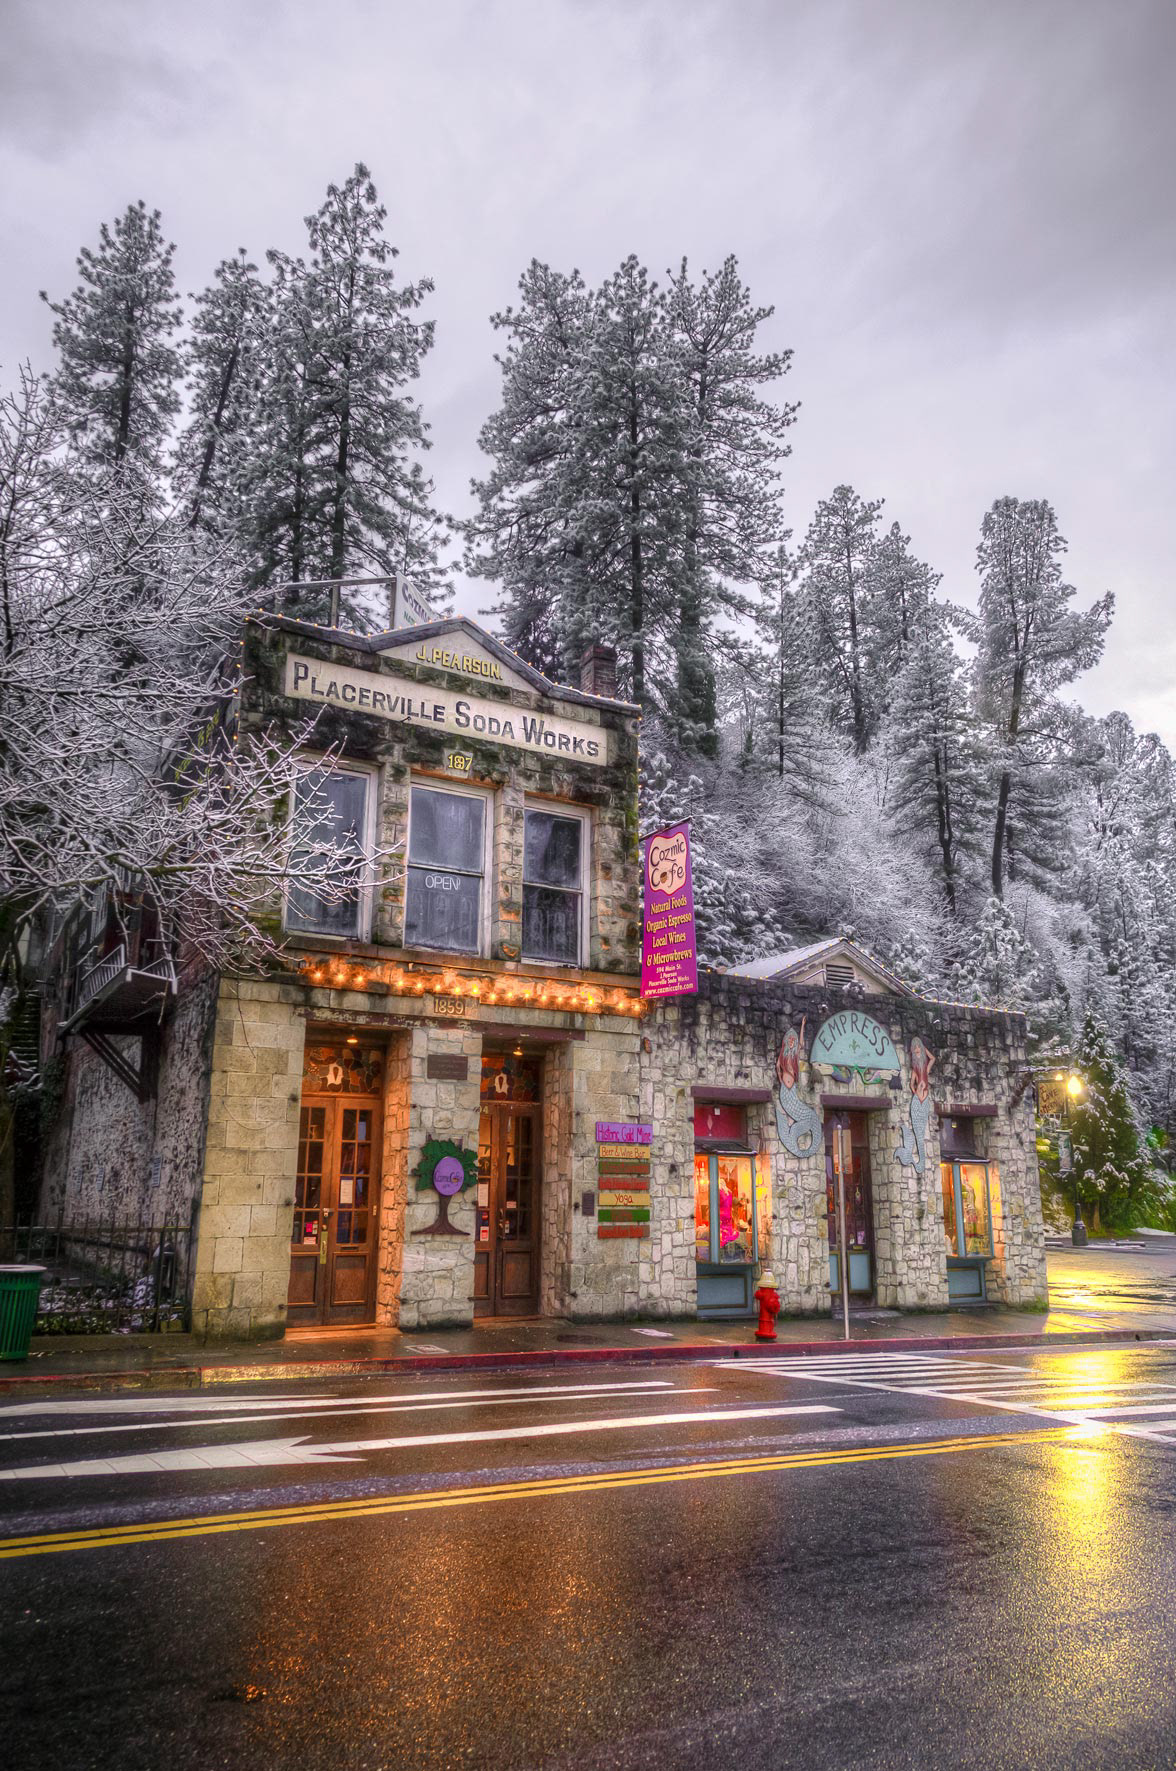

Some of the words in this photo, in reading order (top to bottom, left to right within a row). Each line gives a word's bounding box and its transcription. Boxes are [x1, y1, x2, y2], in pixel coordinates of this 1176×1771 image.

[294, 661, 445, 723] PLACERVILLE
[455, 700, 515, 739] SODA
[522, 715, 599, 758] WORKS
[650, 839, 685, 867] Cozmic
[425, 874, 459, 890] OPEN
[650, 899, 671, 915] Natural
[671, 895, 687, 909] Foods
[646, 916, 667, 933] Organic
[668, 912, 692, 928] Espresso
[652, 933, 667, 948] Local
[668, 931, 686, 945] Wines
[664, 964, 676, 972] Main
[648, 978, 667, 987] Placerville
[667, 976, 678, 984] Soda
[434, 999, 464, 1014] 1859
[818, 1012, 890, 1056] EMPRESS
[602, 1146, 614, 1156] Beer
[620, 1147, 633, 1157] Wine
[635, 1147, 646, 1158] Bar
